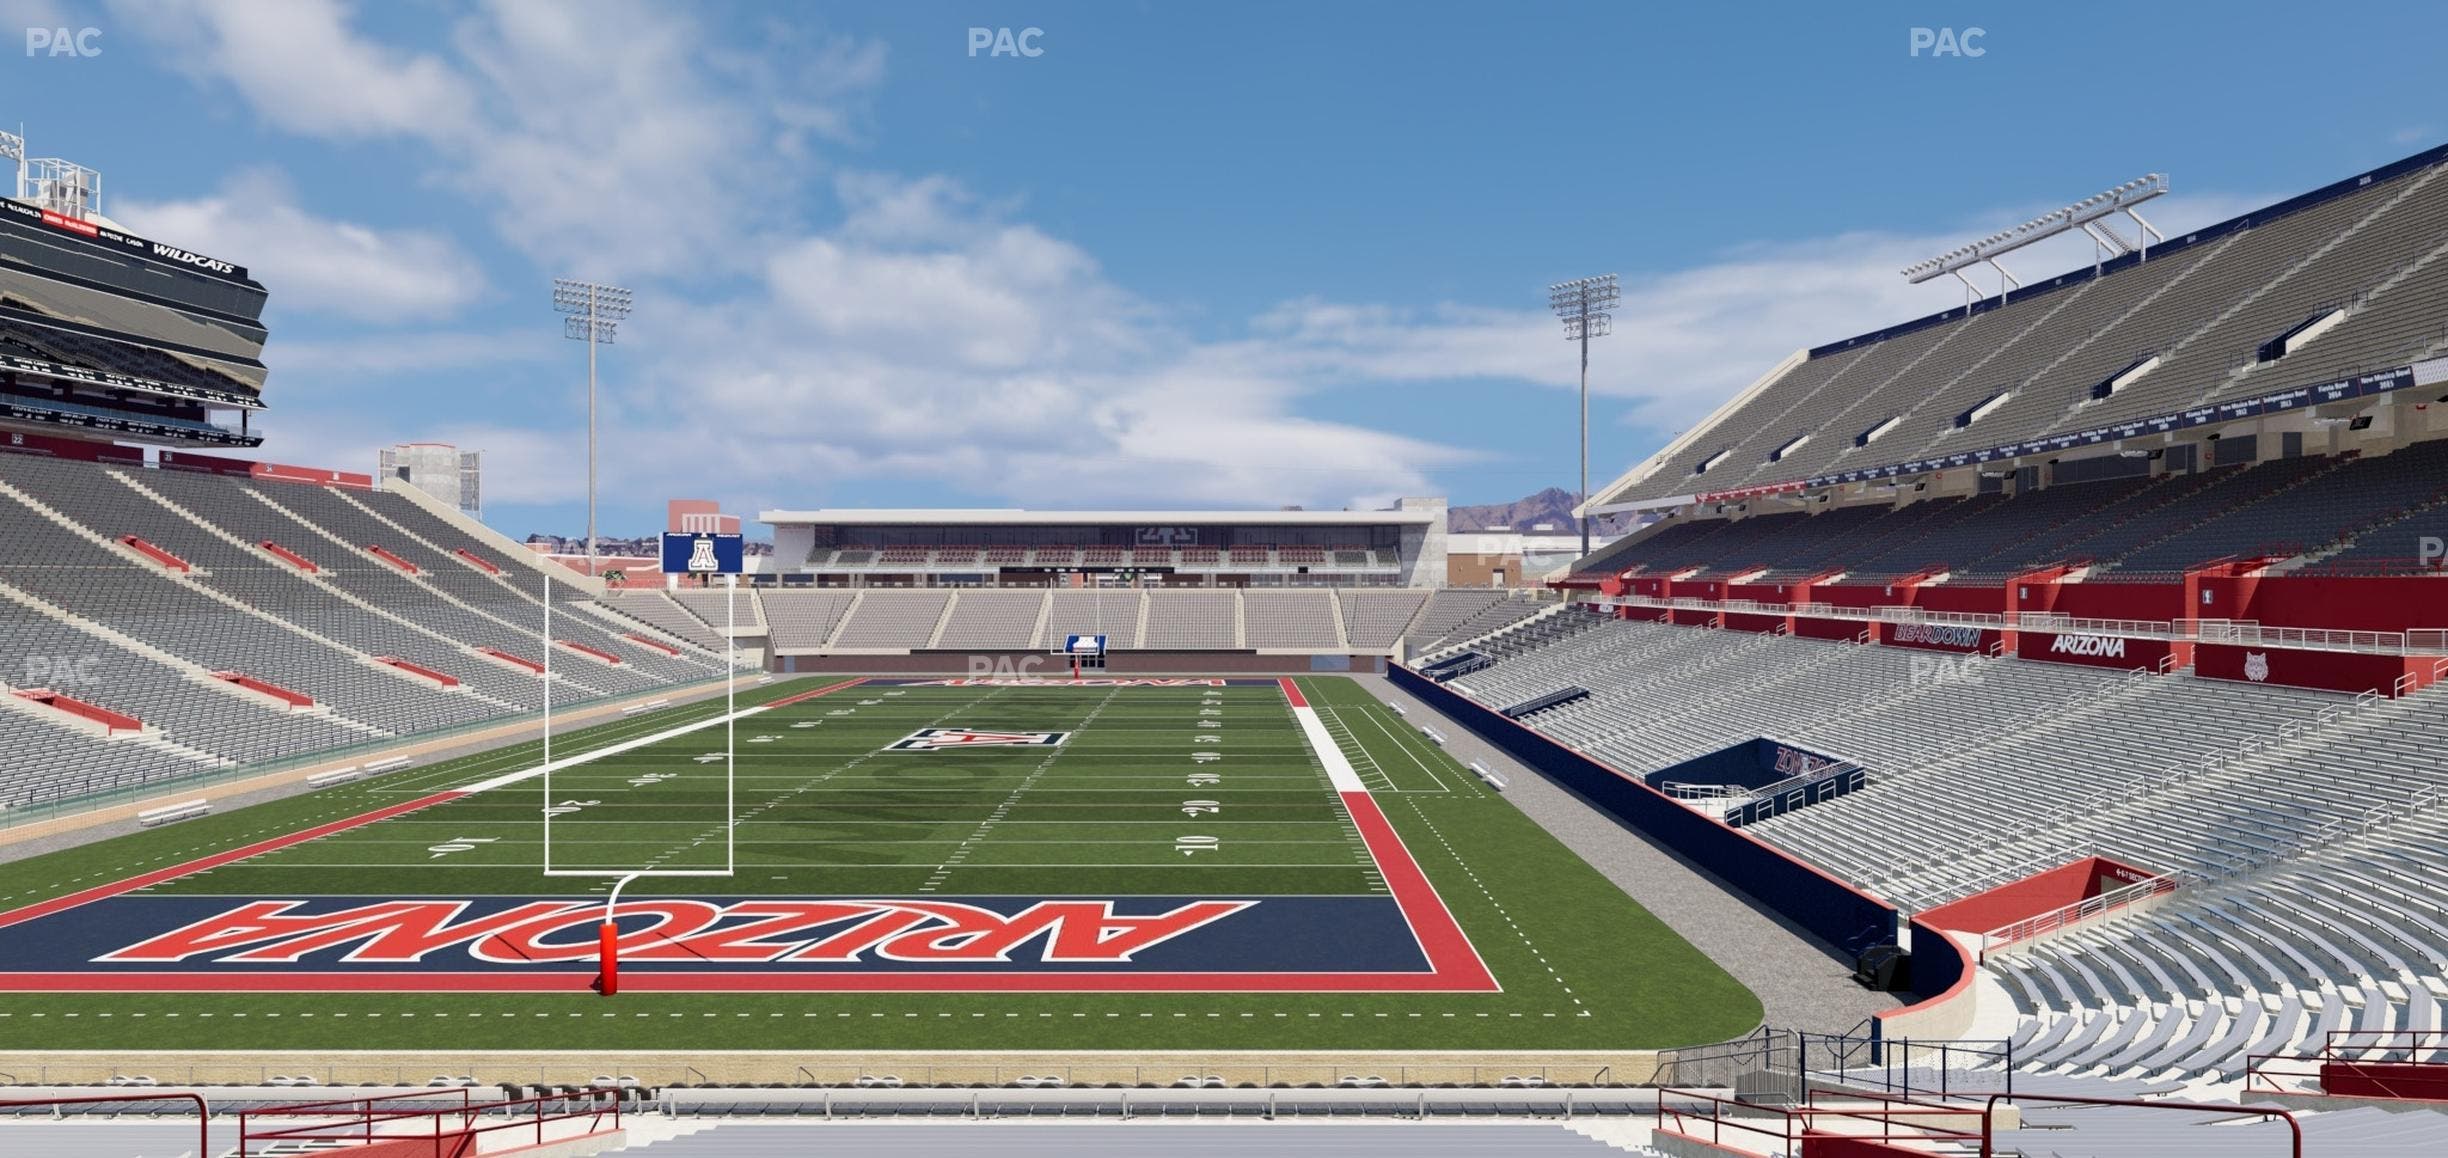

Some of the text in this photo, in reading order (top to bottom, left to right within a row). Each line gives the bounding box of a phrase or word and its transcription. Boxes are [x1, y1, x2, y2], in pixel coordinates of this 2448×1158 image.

[153, 243, 234, 274] WILDCATS
[688, 540, 719, 571] A
[2051, 634, 2125, 659] ARIZONA
[1182, 800, 1220, 813] 20
[428, 836, 501, 852] 10
[1175, 835, 1219, 851] 10
[92, 899, 1262, 964] ARIZONA
